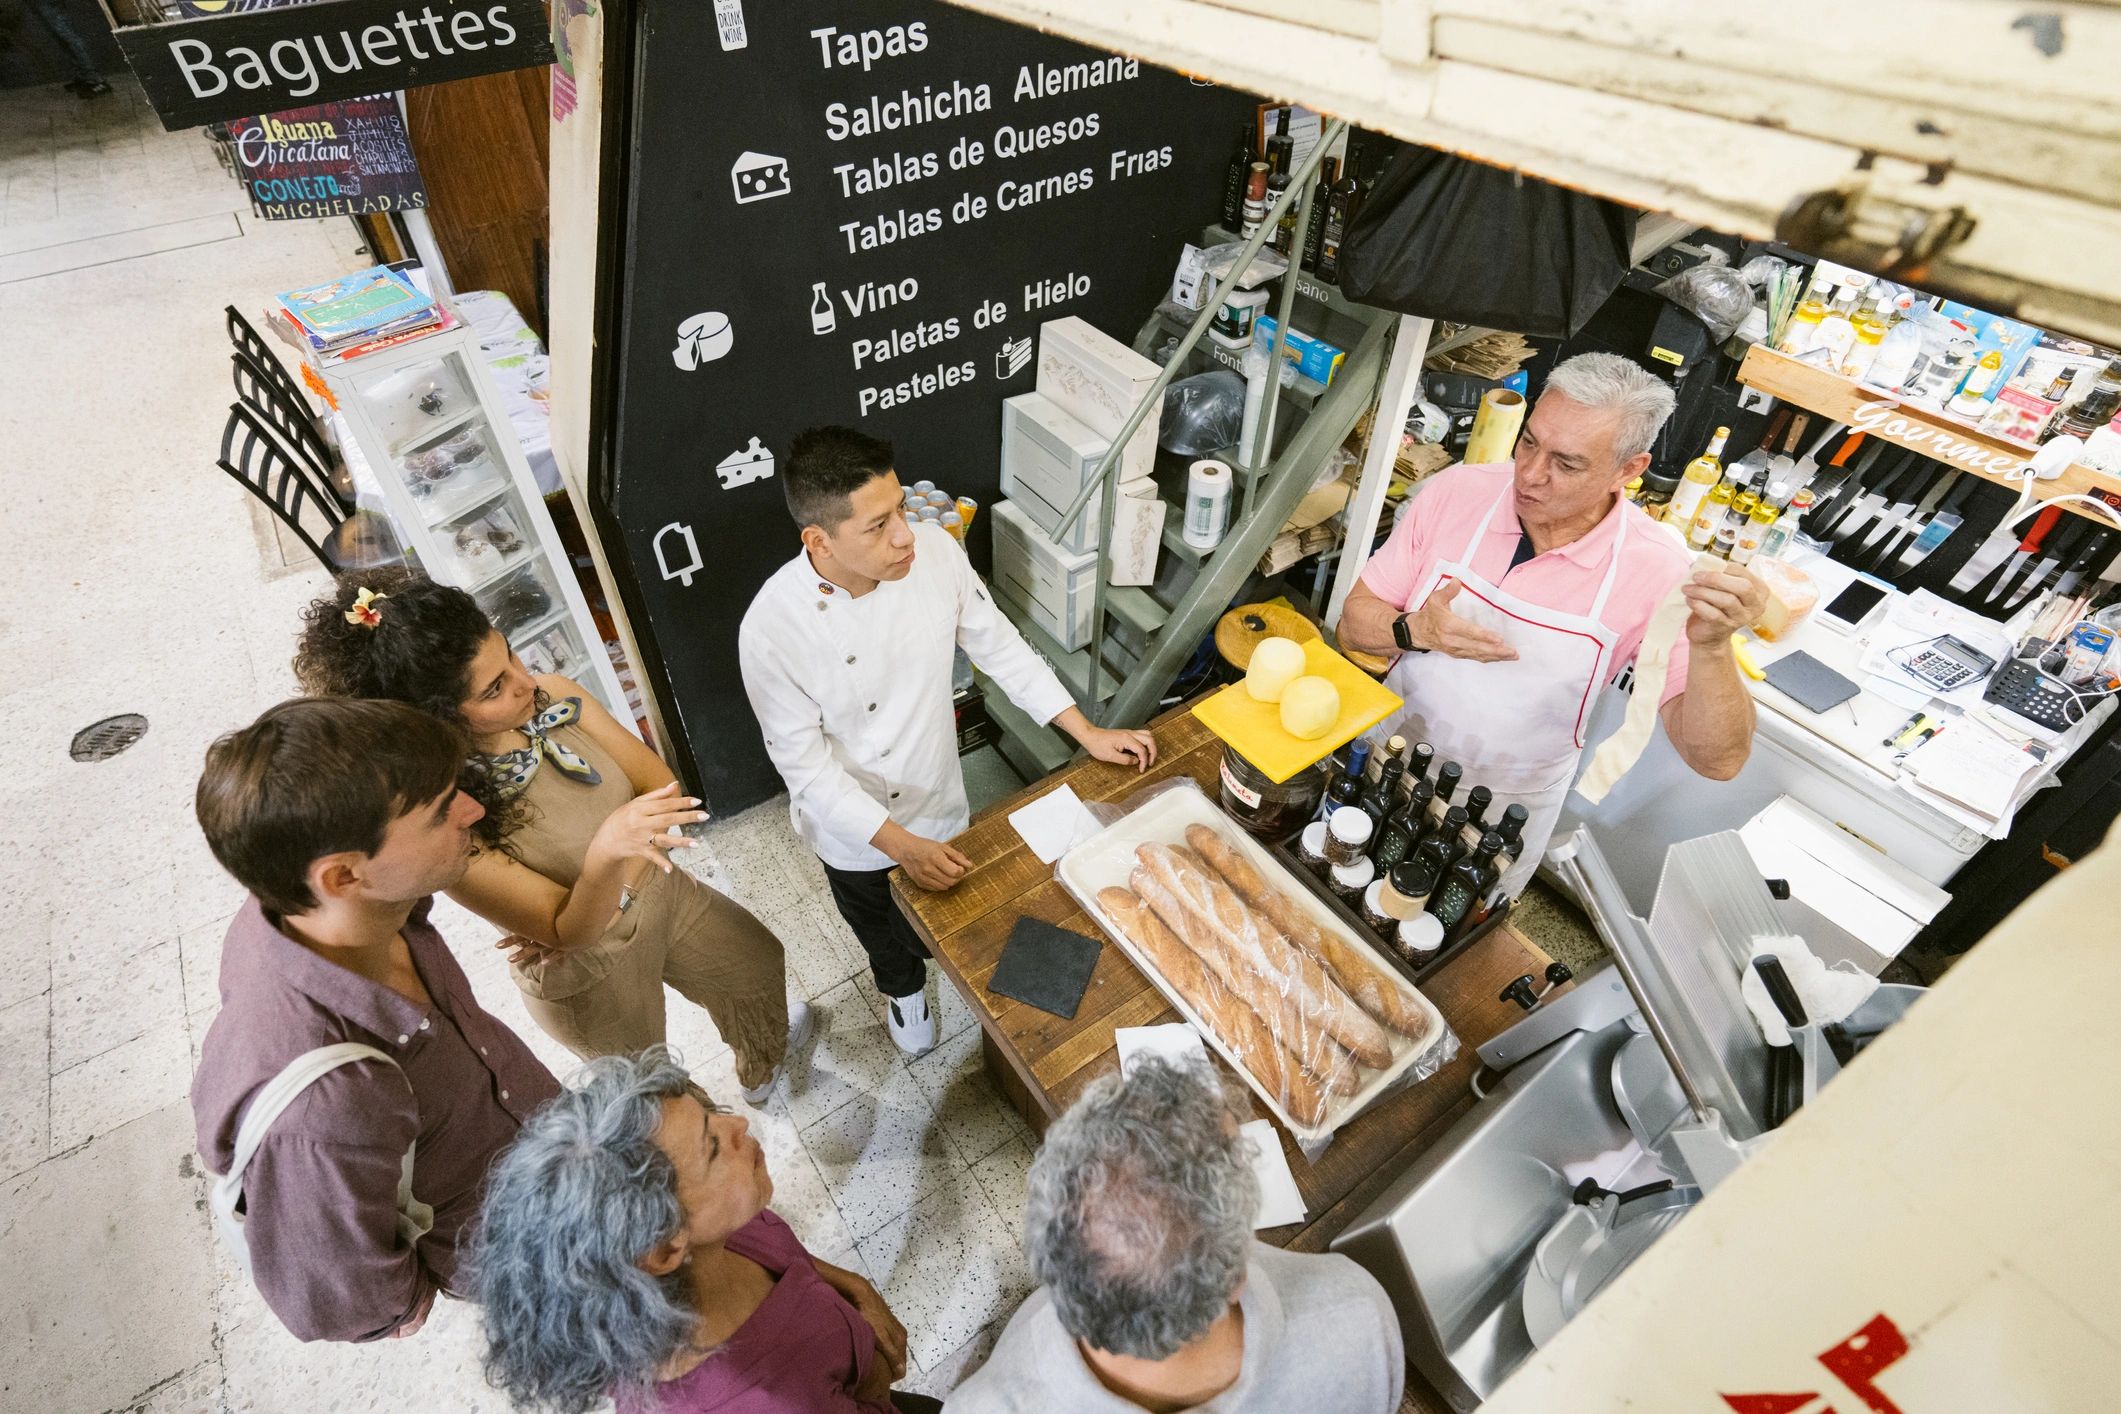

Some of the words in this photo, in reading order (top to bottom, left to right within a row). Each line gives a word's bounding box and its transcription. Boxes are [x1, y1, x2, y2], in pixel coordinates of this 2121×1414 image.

[718, 11, 743, 28] DRINK
[723, 27, 743, 43] WINE
[168, 5, 517, 99] Baguettes
[810, 21, 929, 72] Tapas
[825, 80, 992, 141] Salchicha
[1013, 54, 1139, 103] Alemana
[236, 127, 352, 171] Chicatana
[259, 114, 338, 148] Iguana
[832, 151, 939, 198] Tablas
[948, 136, 985, 171] de
[994, 113, 1100, 159] Quesos
[254, 175, 340, 201] CONEJO
[839, 208, 943, 254] Tablas
[952, 192, 988, 224] de
[996, 167, 1094, 212] Carnes
[1110, 145, 1173, 181] Frias
[840, 277, 919, 318] Vino
[852, 317, 961, 371] Paletas
[973, 299, 1007, 330] de
[1024, 272, 1091, 312] Hielo
[858, 361, 976, 417] Pasteles
